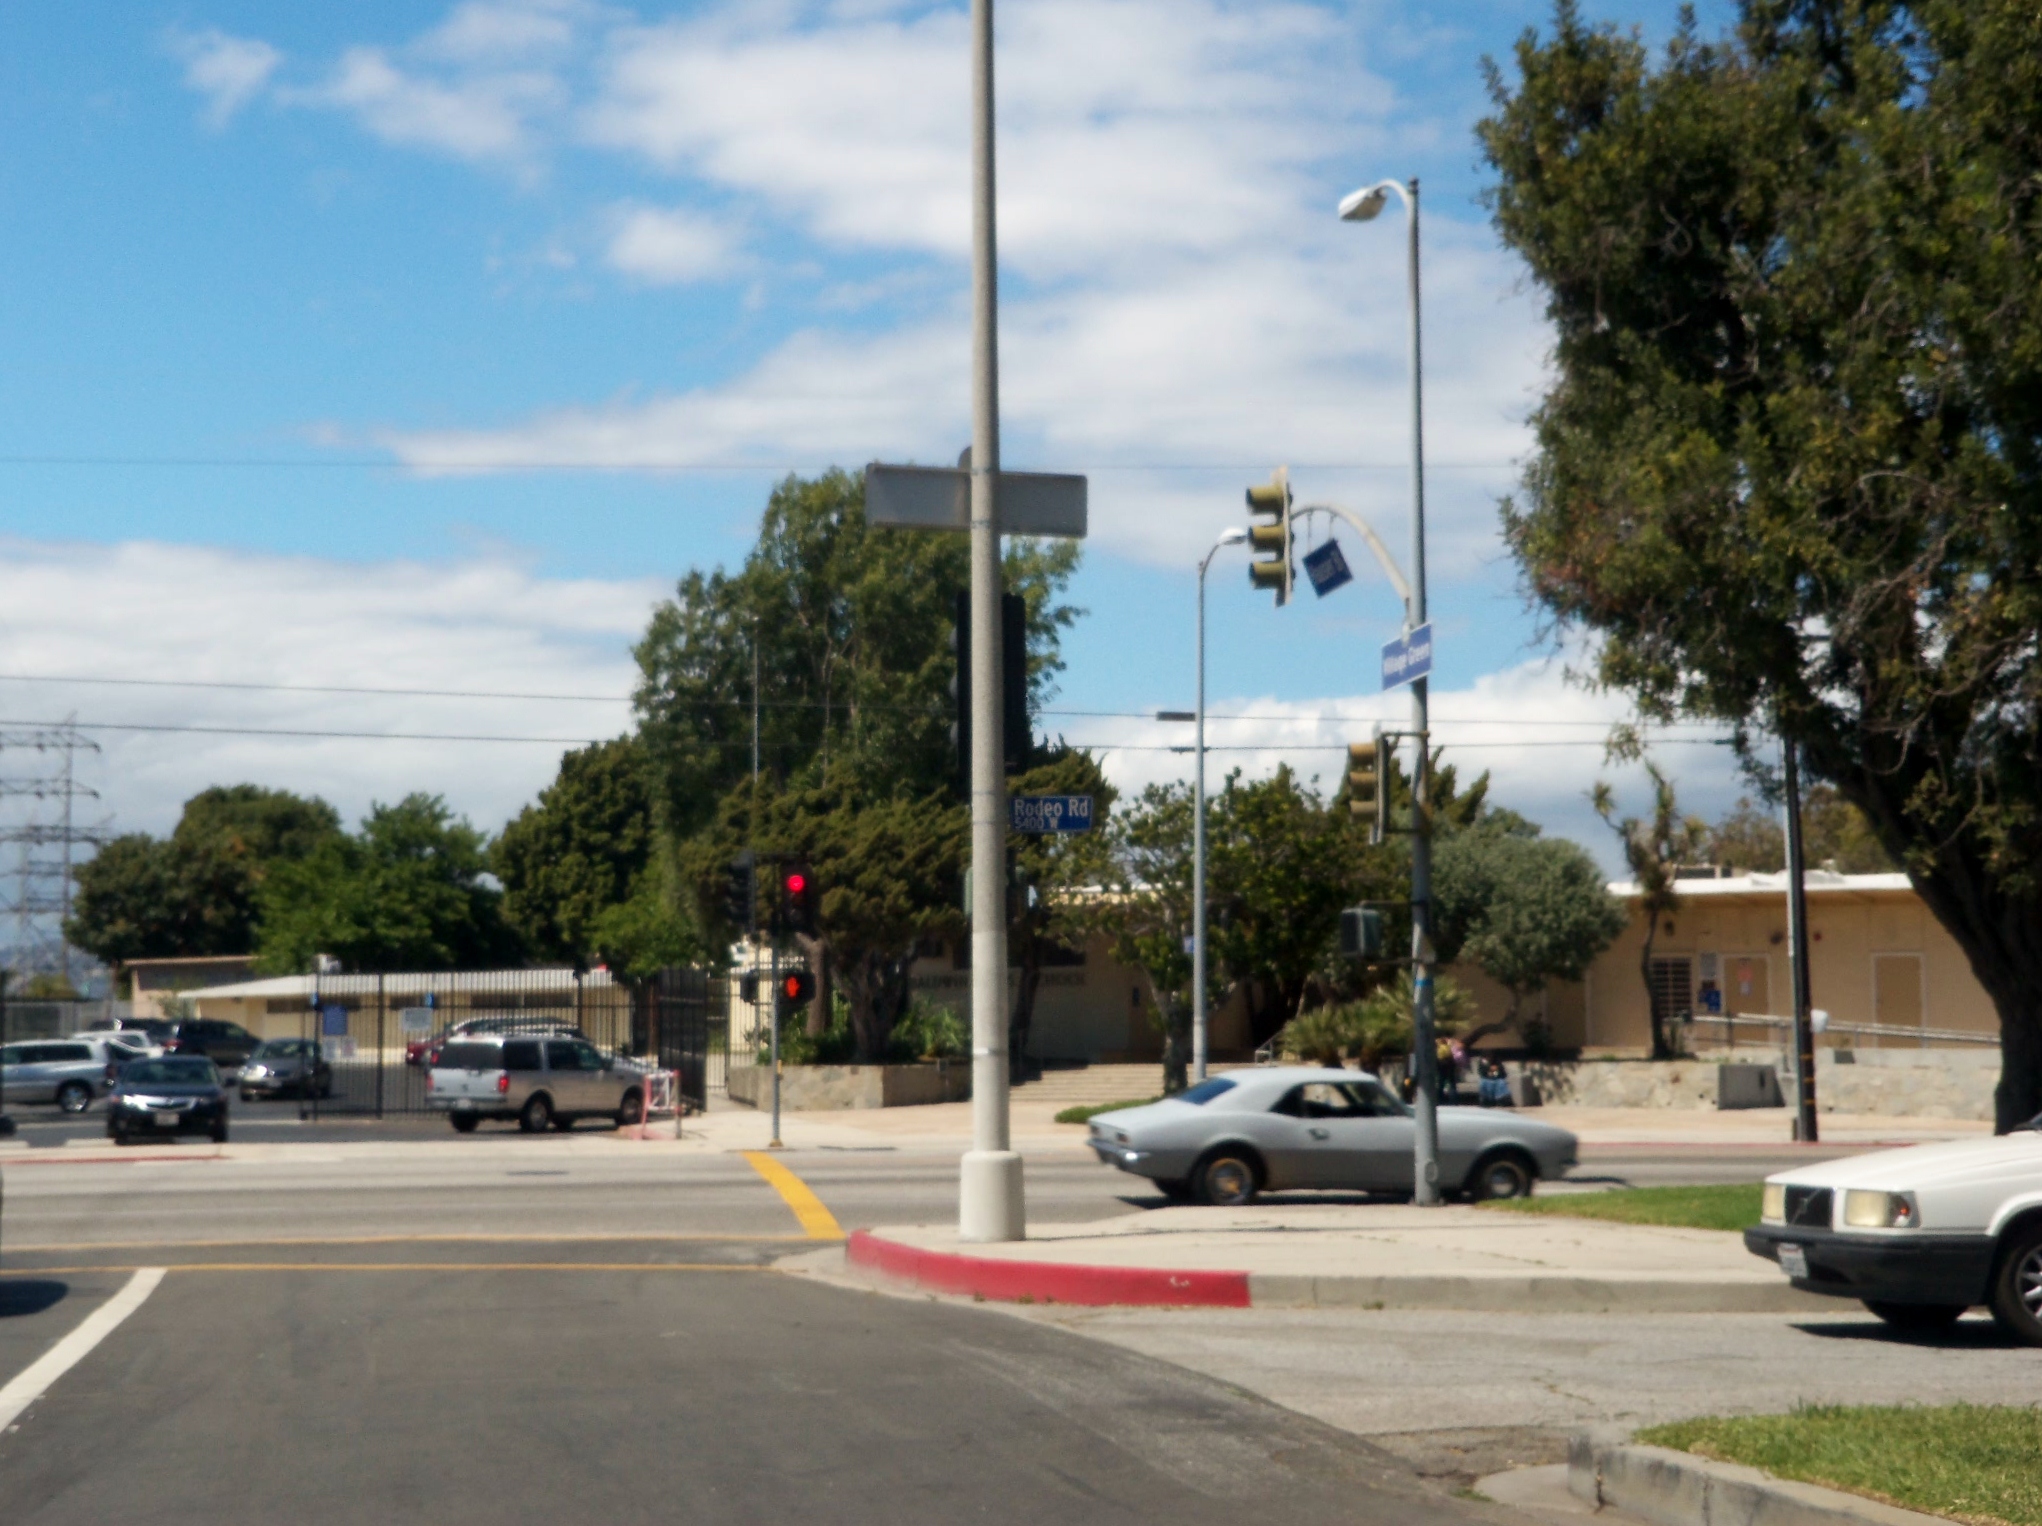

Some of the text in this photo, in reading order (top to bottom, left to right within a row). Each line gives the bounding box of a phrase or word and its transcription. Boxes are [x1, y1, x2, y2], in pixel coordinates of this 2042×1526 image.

[1014, 797, 1088, 817] Rodeo Rd
[1014, 816, 1059, 829] 5400 W
